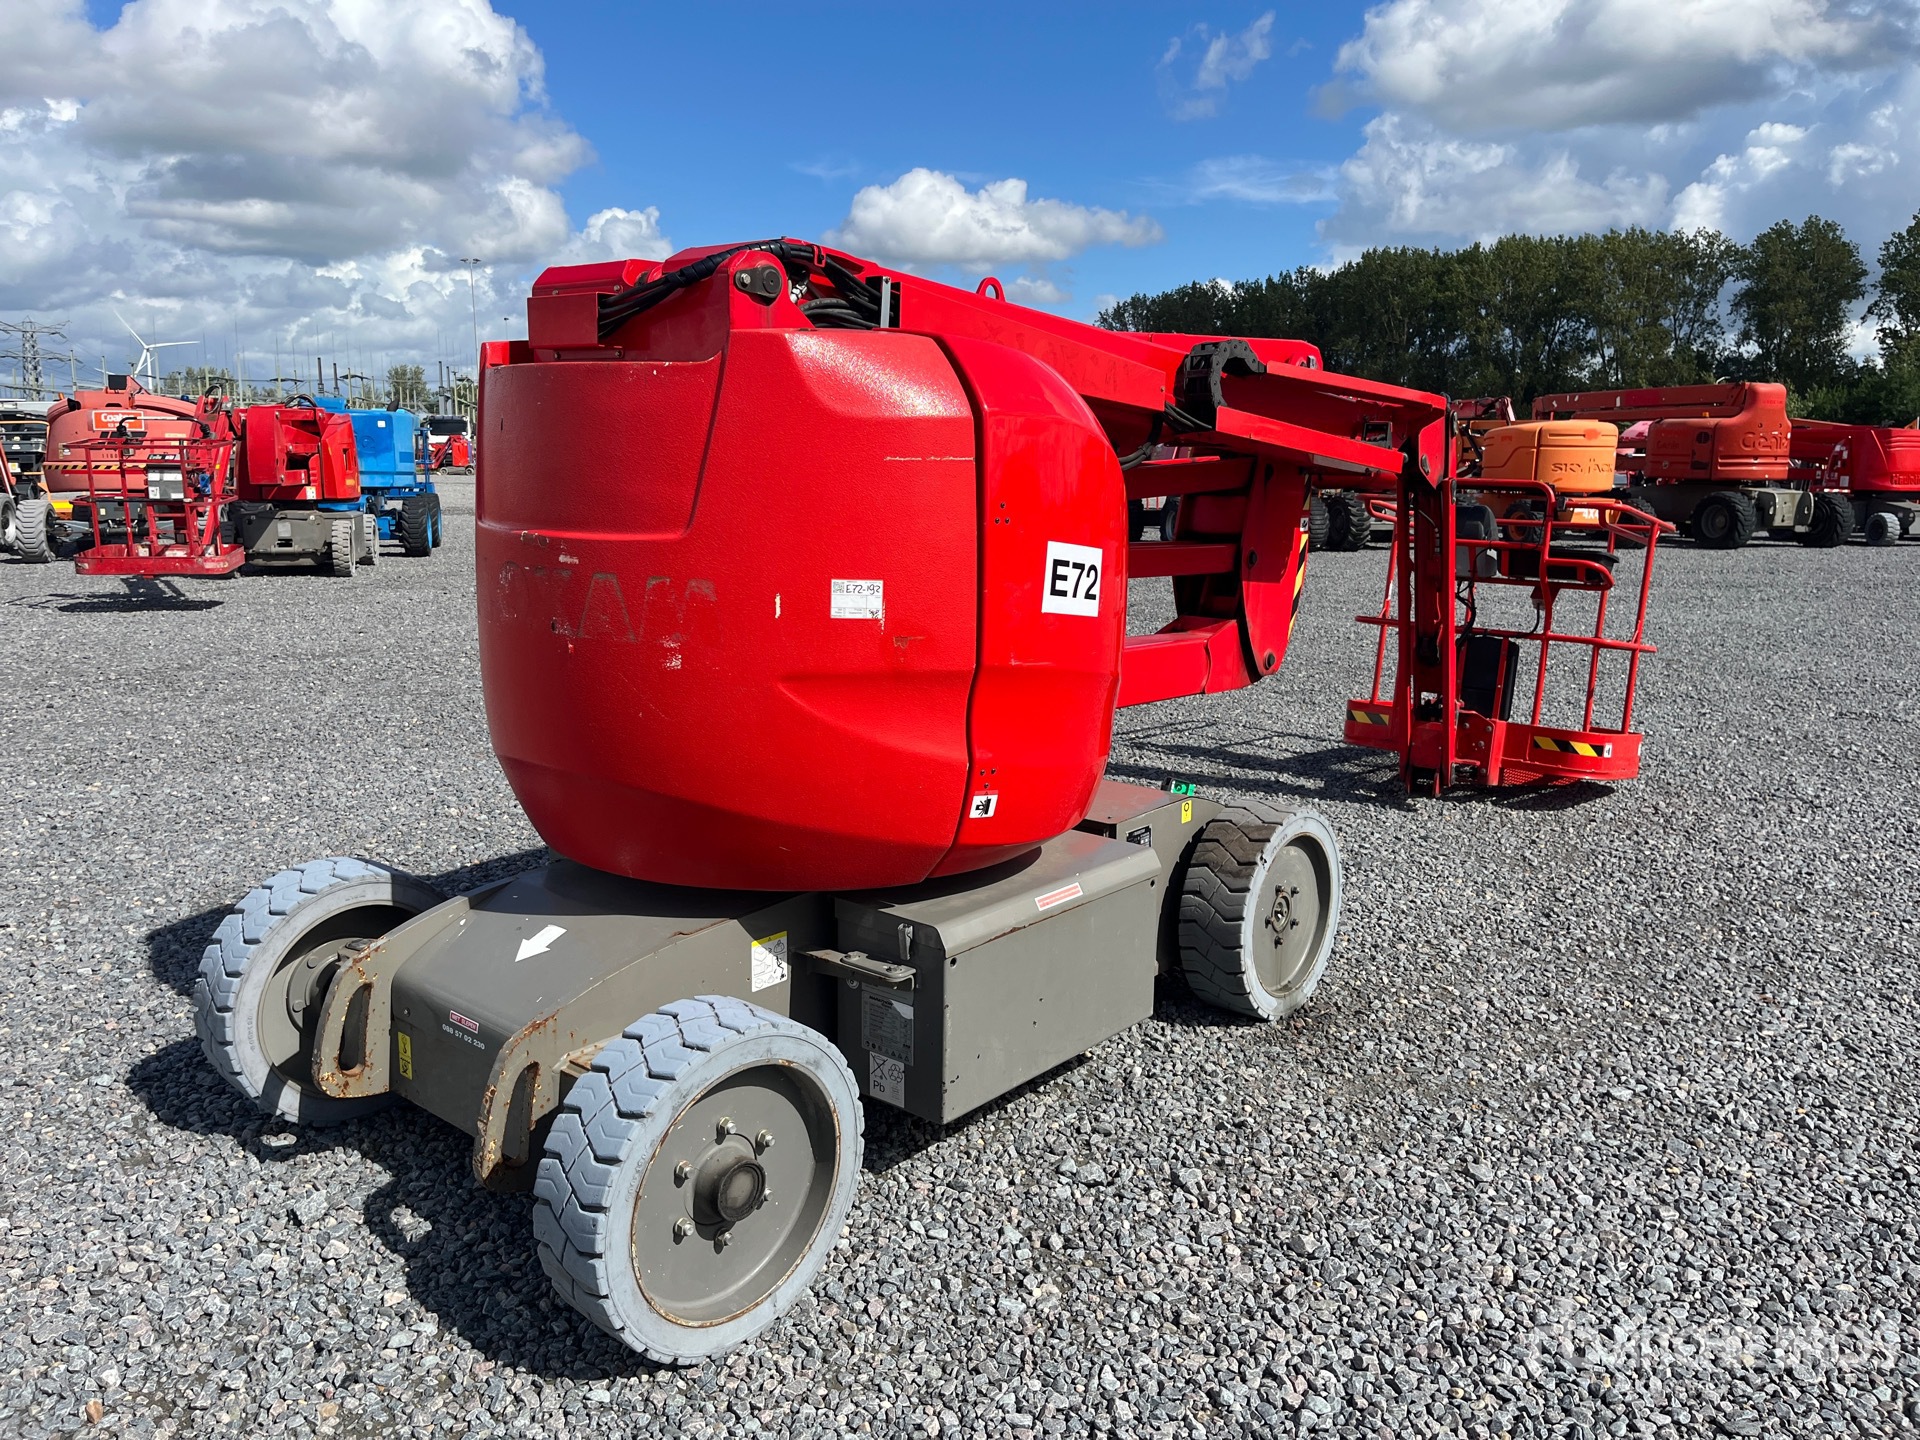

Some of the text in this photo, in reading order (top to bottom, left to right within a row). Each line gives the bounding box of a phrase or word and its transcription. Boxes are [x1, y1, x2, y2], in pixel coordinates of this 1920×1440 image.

[1740, 431, 1788, 451] Genie
[1050, 558, 1098, 600] E72
[846, 583, 881, 595] E72-192
[873, 1080, 886, 1093] Pb
